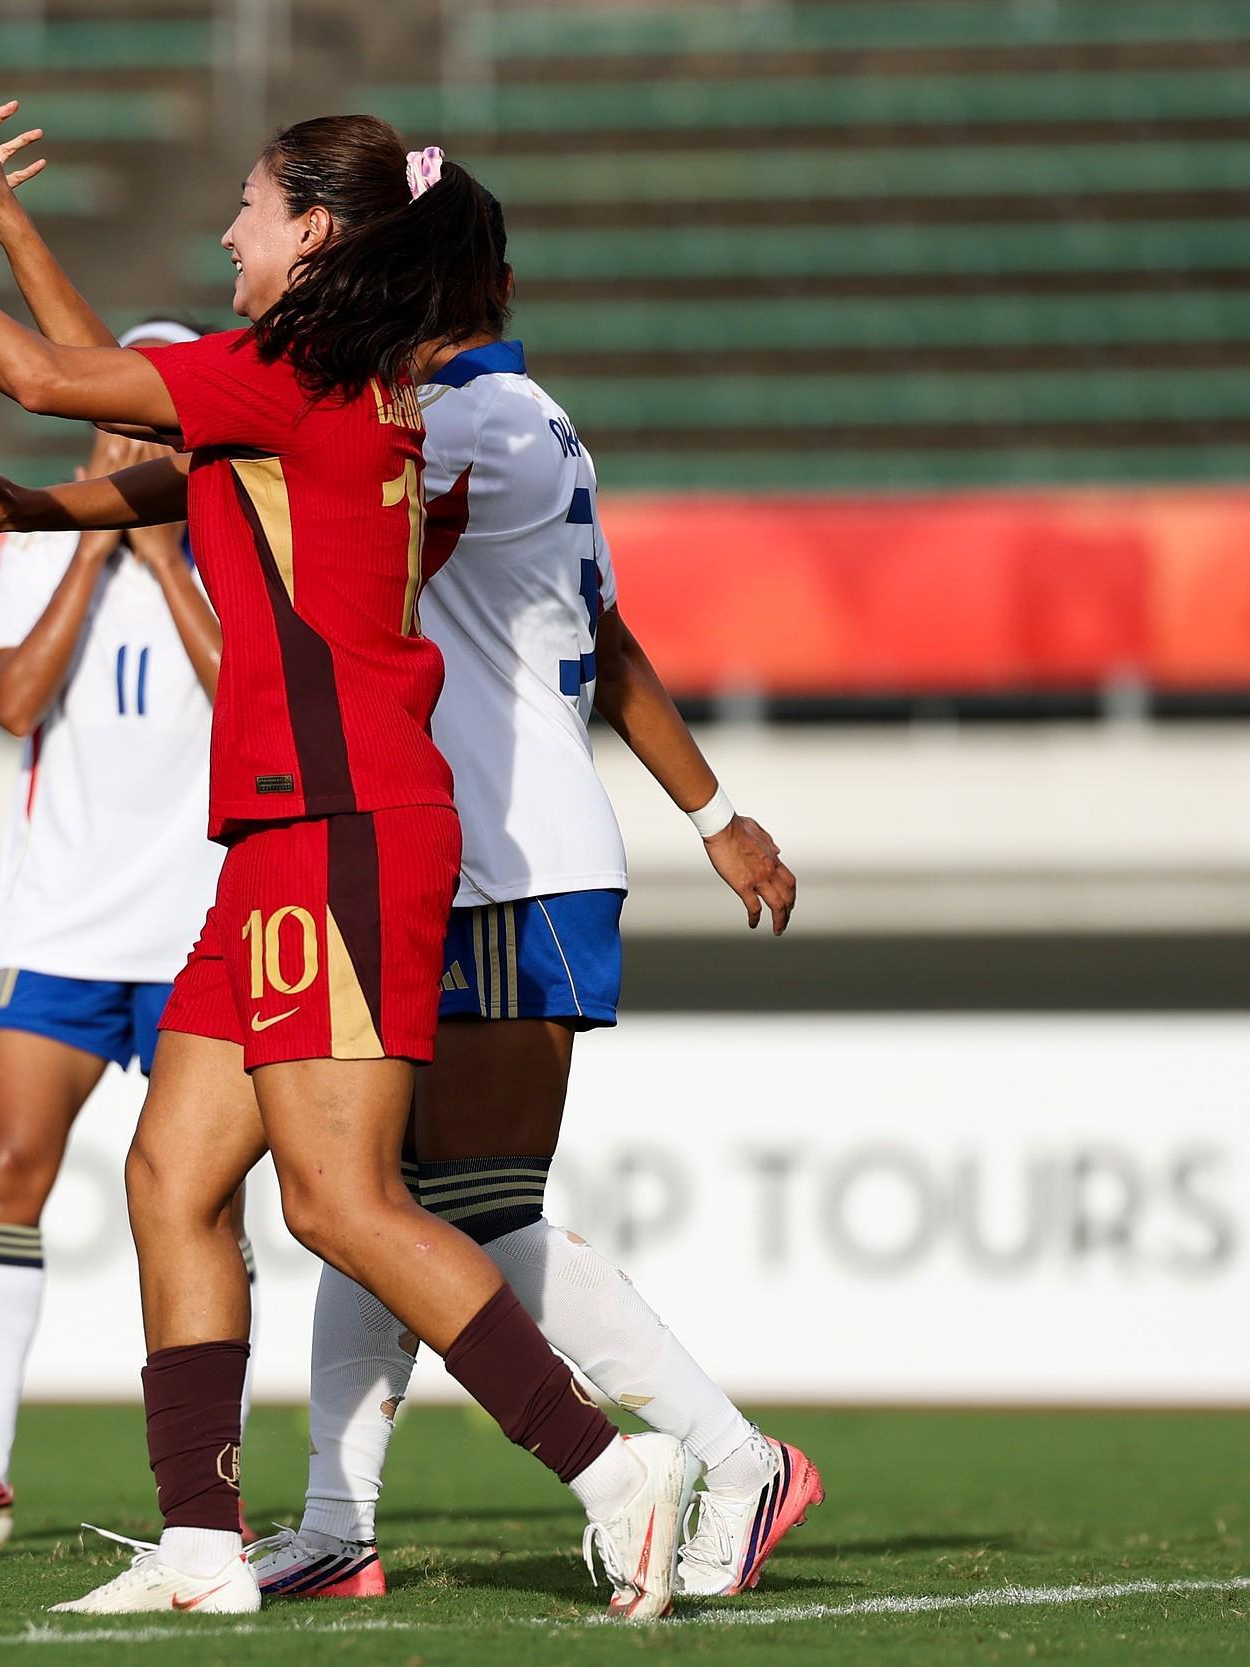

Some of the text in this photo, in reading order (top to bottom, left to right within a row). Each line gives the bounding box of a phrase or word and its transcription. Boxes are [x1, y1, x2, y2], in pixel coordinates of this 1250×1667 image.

[116, 644, 150, 716] 11
[242, 905, 319, 1000] 10
[744, 1142, 1241, 1280] TOURS
